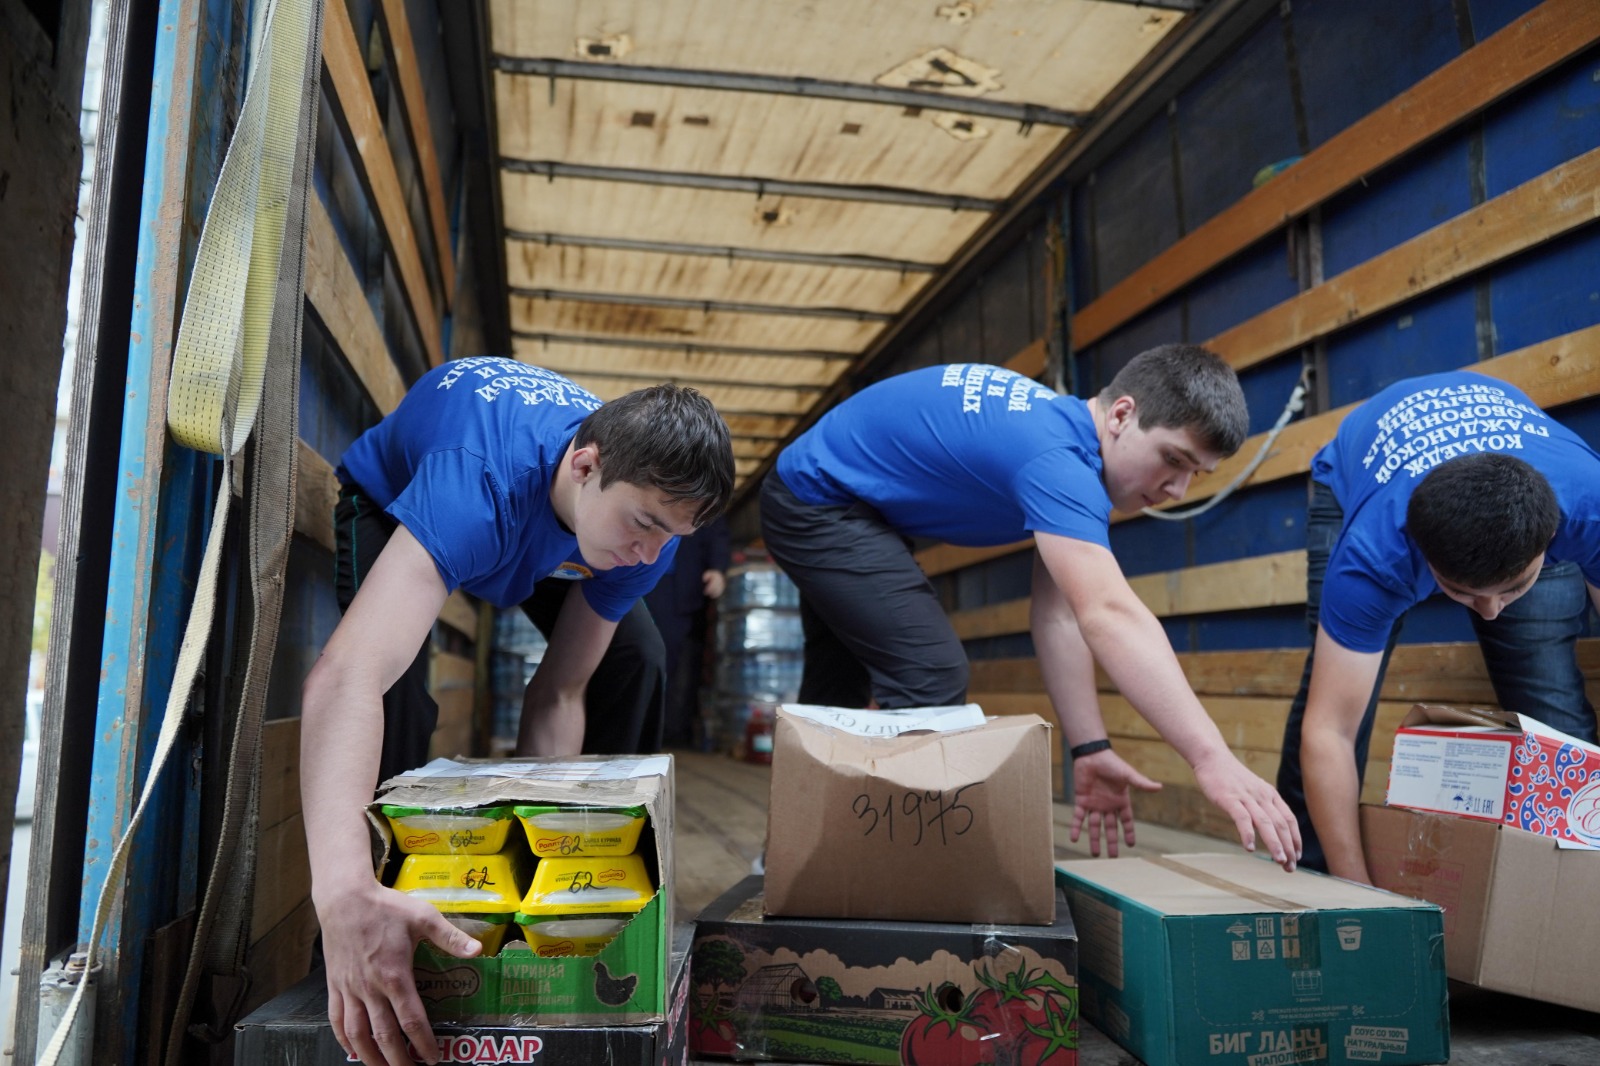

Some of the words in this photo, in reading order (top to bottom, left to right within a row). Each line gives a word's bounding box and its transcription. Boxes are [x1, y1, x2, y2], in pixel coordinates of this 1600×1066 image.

[1401, 405, 1523, 440] ОБОРОНЫ
[1374, 418, 1550, 484] ГРАЖДАНСКОЙ
[1382, 437, 1399, 458] И
[1402, 433, 1524, 479] КОЛЛЕДЖ
[851, 780, 986, 847] 31975
[560, 835, 584, 855] 62
[465, 866, 497, 890] 62
[567, 870, 608, 894] 62
[503, 964, 565, 979] КУРИНАЯ
[1209, 1032, 1251, 1056] БИГ
[1258, 1027, 1322, 1053] ЛАНЧ
[1354, 1027, 1375, 1037] СОУС
[1376, 1028, 1387, 1037] СО
[405, 1035, 544, 1064] НОДАР
[1254, 1047, 1321, 1066] НАПОЛНЯЕТ
[1347, 1038, 1405, 1051] НАТУРАЛЬНЫМ
[1350, 1050, 1378, 1059] МЯСОМ
